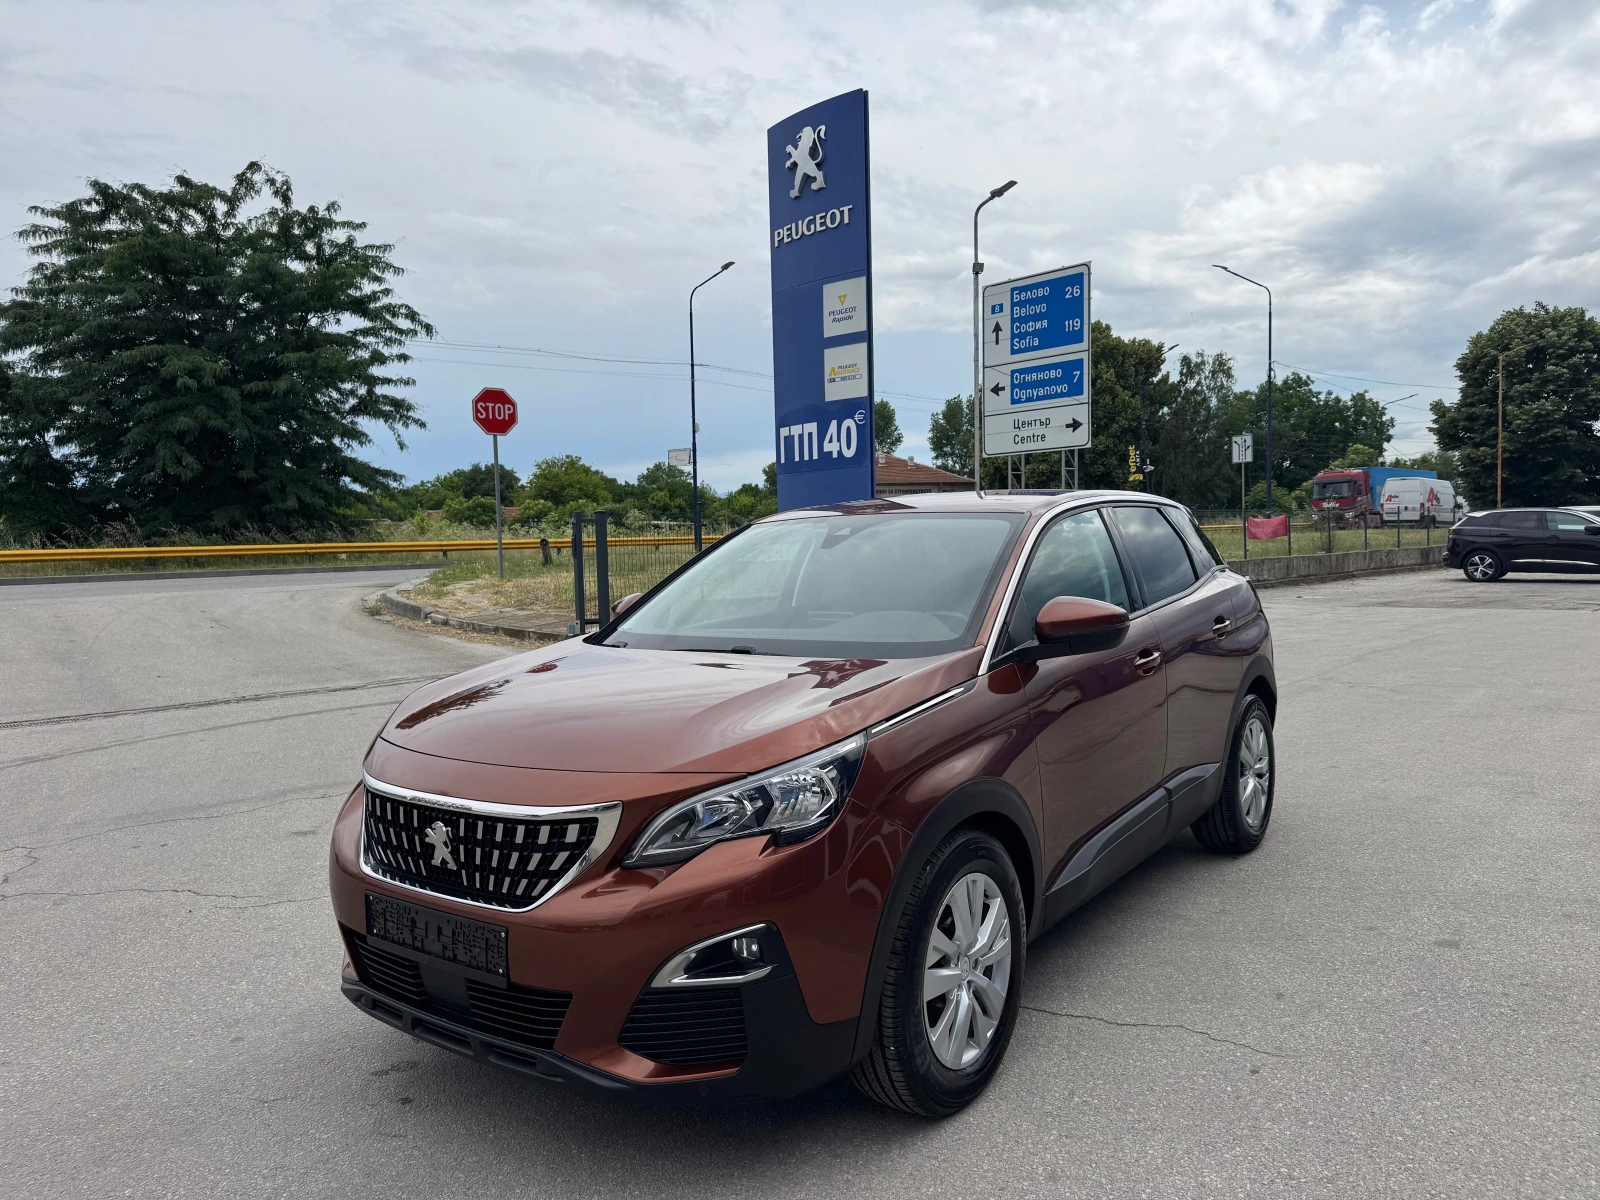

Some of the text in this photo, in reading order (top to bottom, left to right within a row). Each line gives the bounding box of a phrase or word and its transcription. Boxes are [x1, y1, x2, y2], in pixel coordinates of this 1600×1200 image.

[775, 205, 853, 247] PEUGEOT
[1013, 285, 1081, 302] Белово 26
[828, 306, 858, 317] PEUGEOT
[994, 305, 1000, 313] 8
[1013, 303, 1047, 318] Belovo
[831, 314, 854, 324] Rapide
[1013, 318, 1081, 334] София 119
[1013, 336, 1039, 350] Sofia
[1013, 369, 1081, 384] Огняново 7
[1013, 384, 1069, 401] Ognyanovo
[477, 402, 514, 420] STOP
[1013, 417, 1051, 431] Център
[780, 422, 818, 464] ГТП
[1013, 433, 1046, 445] Centre
[1128, 445, 1137, 472] efbet
